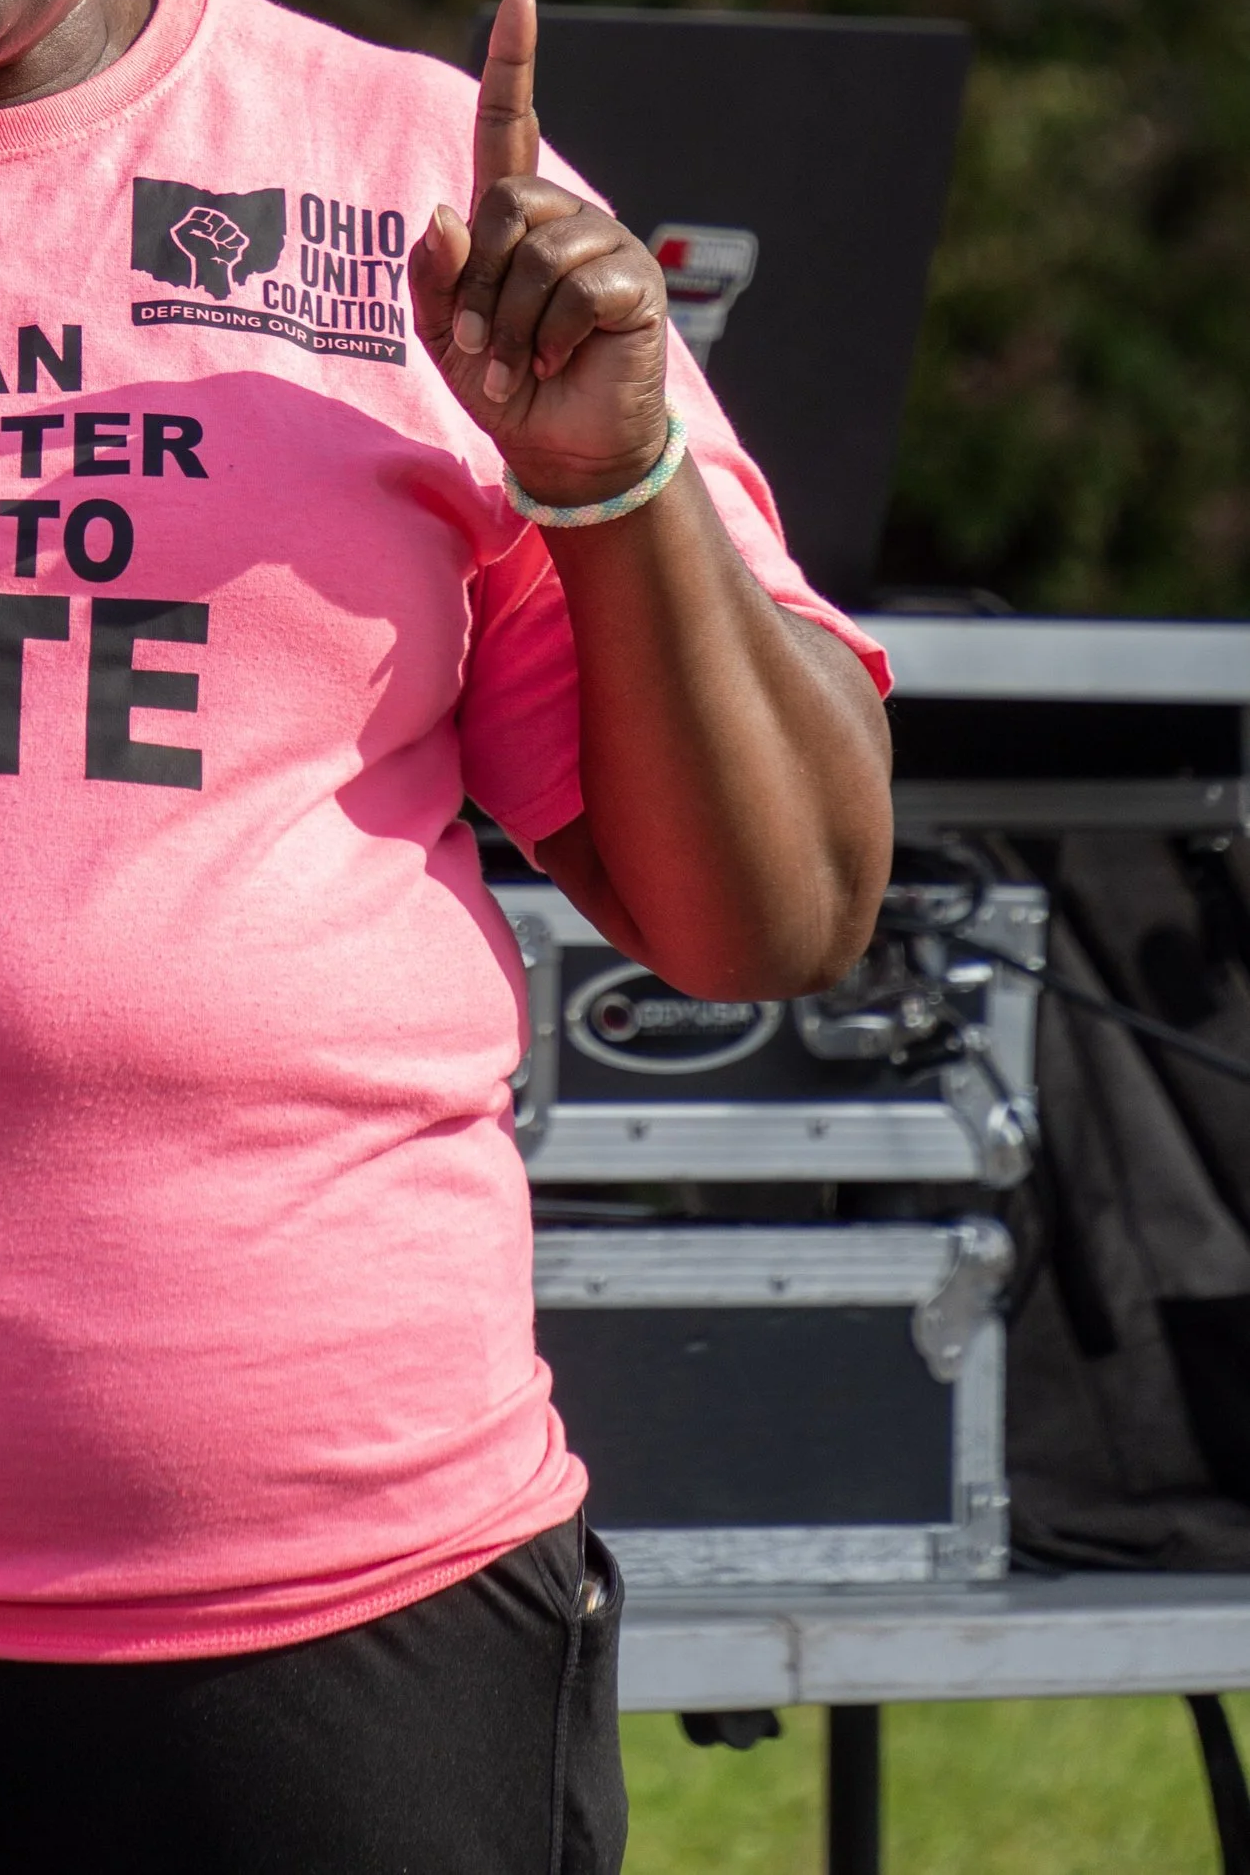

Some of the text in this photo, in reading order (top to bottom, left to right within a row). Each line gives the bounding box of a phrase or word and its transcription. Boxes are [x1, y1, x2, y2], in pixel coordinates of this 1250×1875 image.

[300, 193, 405, 258] OHIO
[301, 244, 405, 302] UNITY
[140, 306, 397, 357] DEFENDING OUR DIGNITY
[263, 279, 405, 339] COALITION
